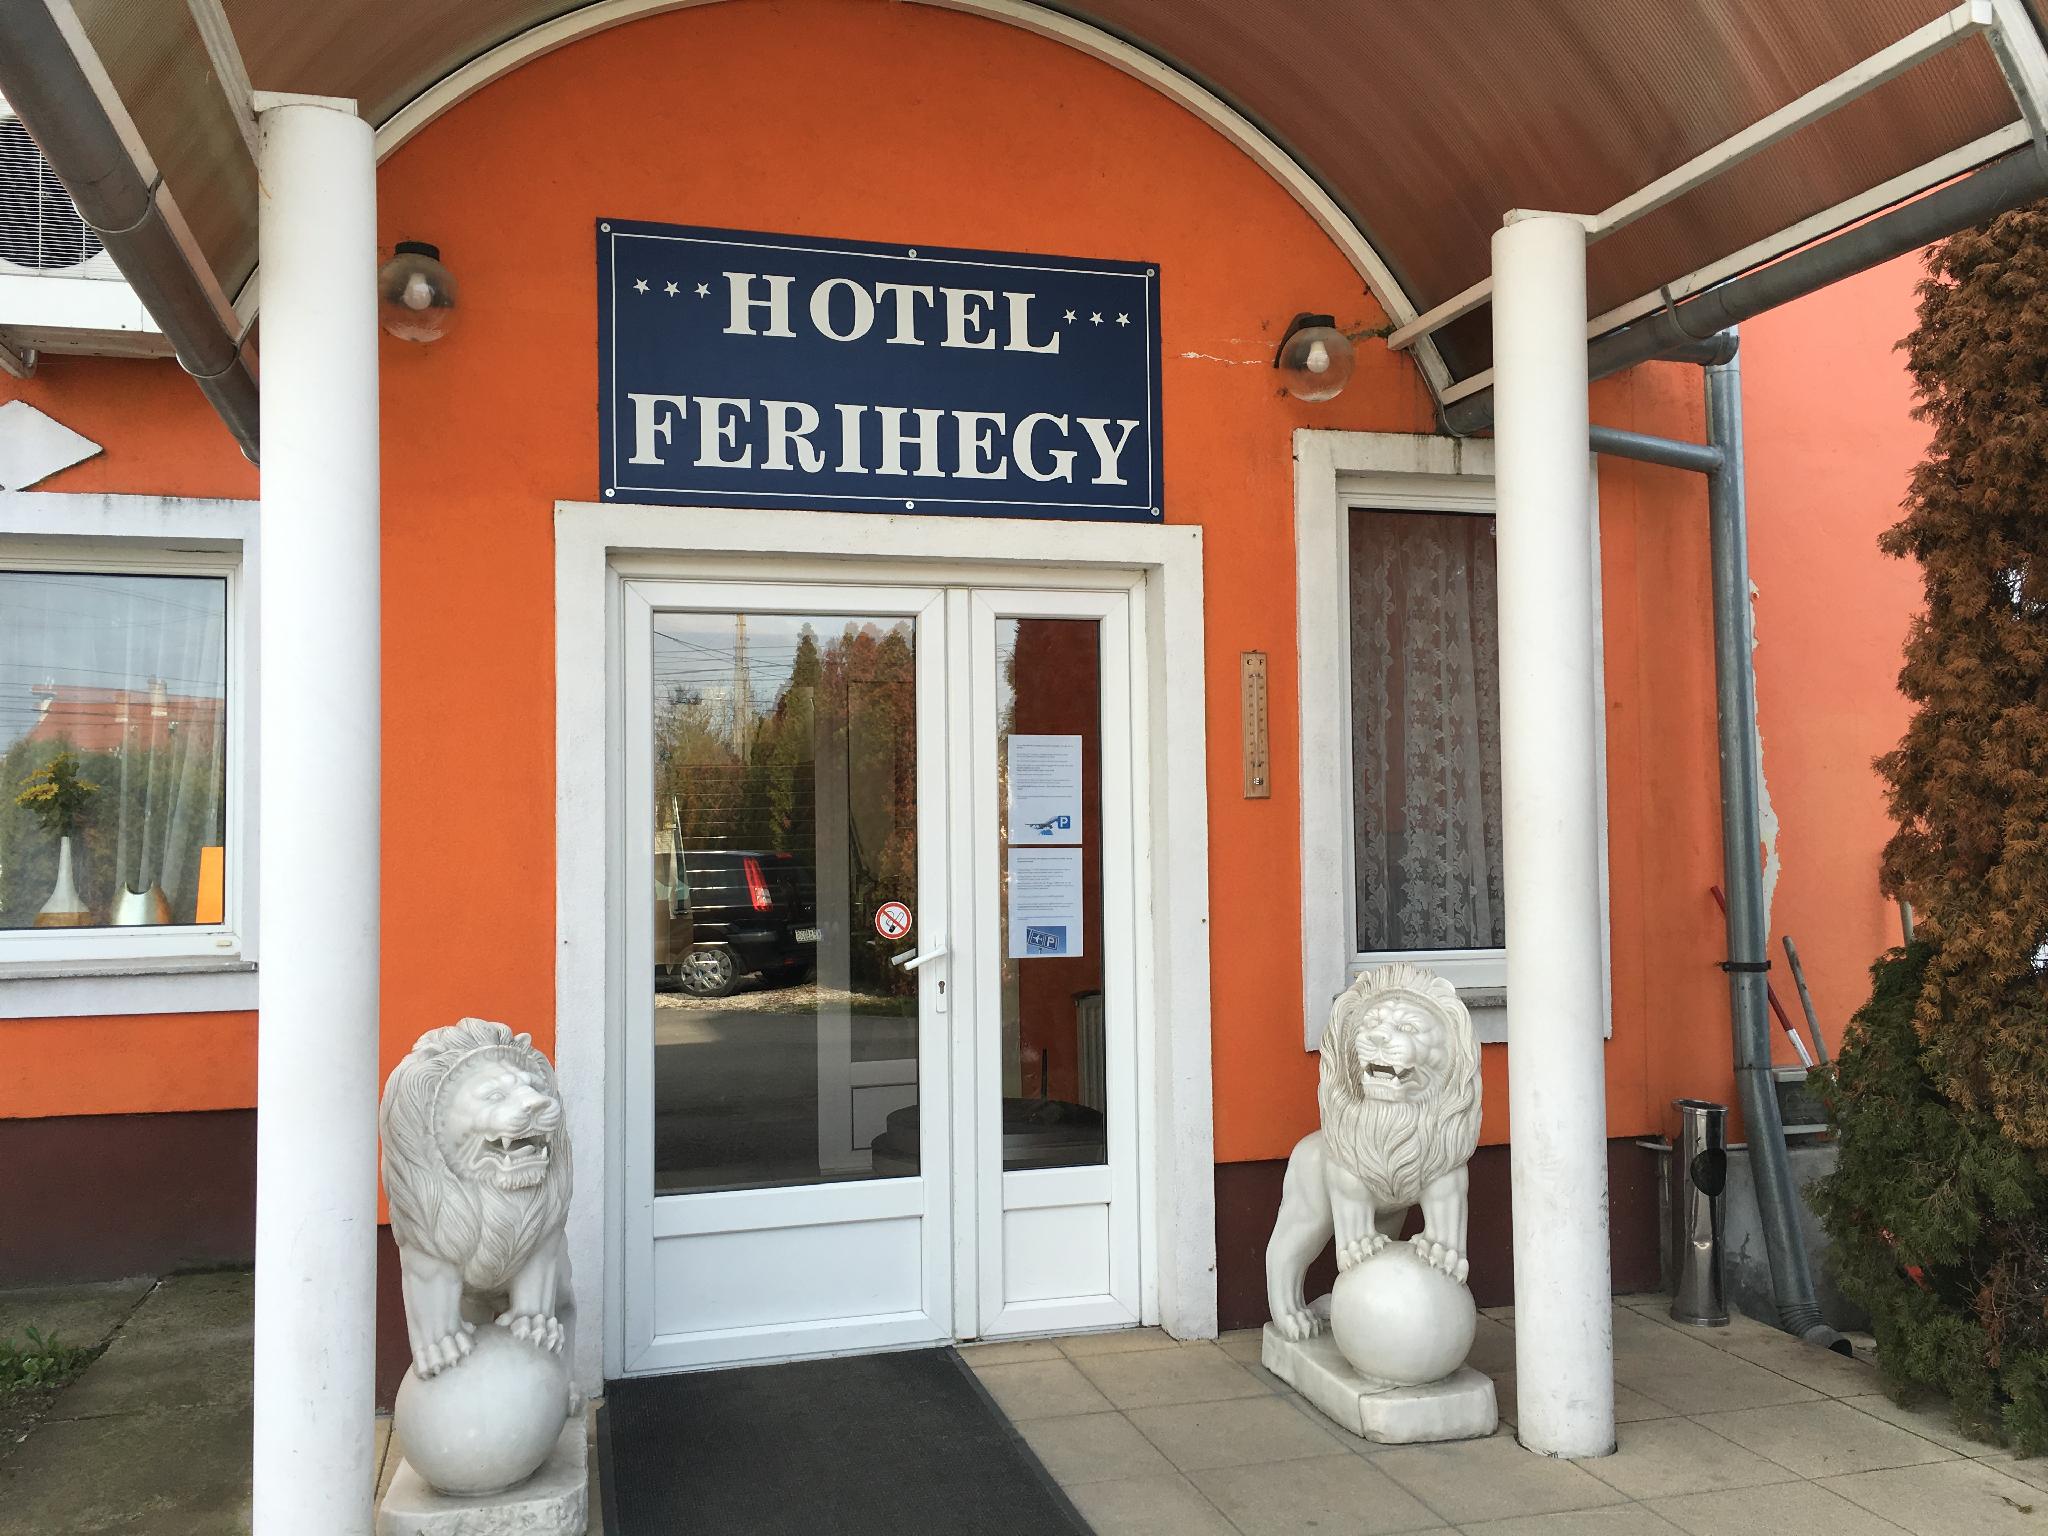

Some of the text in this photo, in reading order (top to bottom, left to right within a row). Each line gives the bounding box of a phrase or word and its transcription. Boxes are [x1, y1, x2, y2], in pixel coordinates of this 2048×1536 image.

[722, 271, 1060, 355] HOTEL
[627, 392, 1140, 486] FERIHEGY
[1060, 817, 1068, 828] P
[1047, 936, 1055, 947] P
